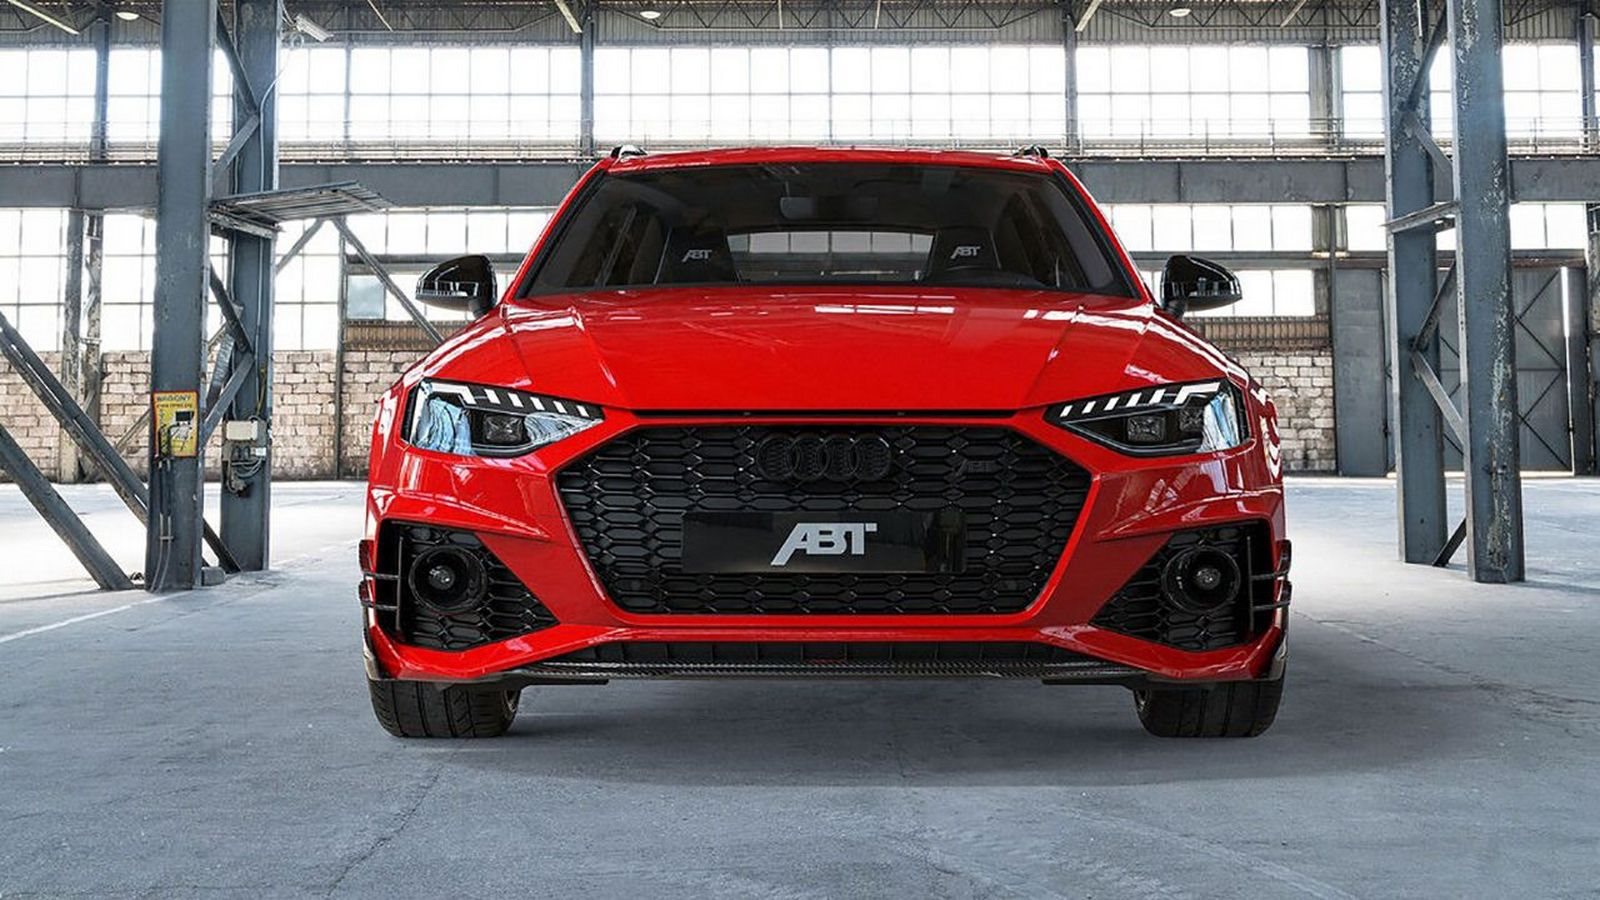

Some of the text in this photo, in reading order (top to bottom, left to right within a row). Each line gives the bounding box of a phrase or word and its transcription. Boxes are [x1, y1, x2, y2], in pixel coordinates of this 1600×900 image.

[682, 249, 712, 262] ABT
[951, 246, 981, 259] ABT
[770, 522, 878, 566] ABT
